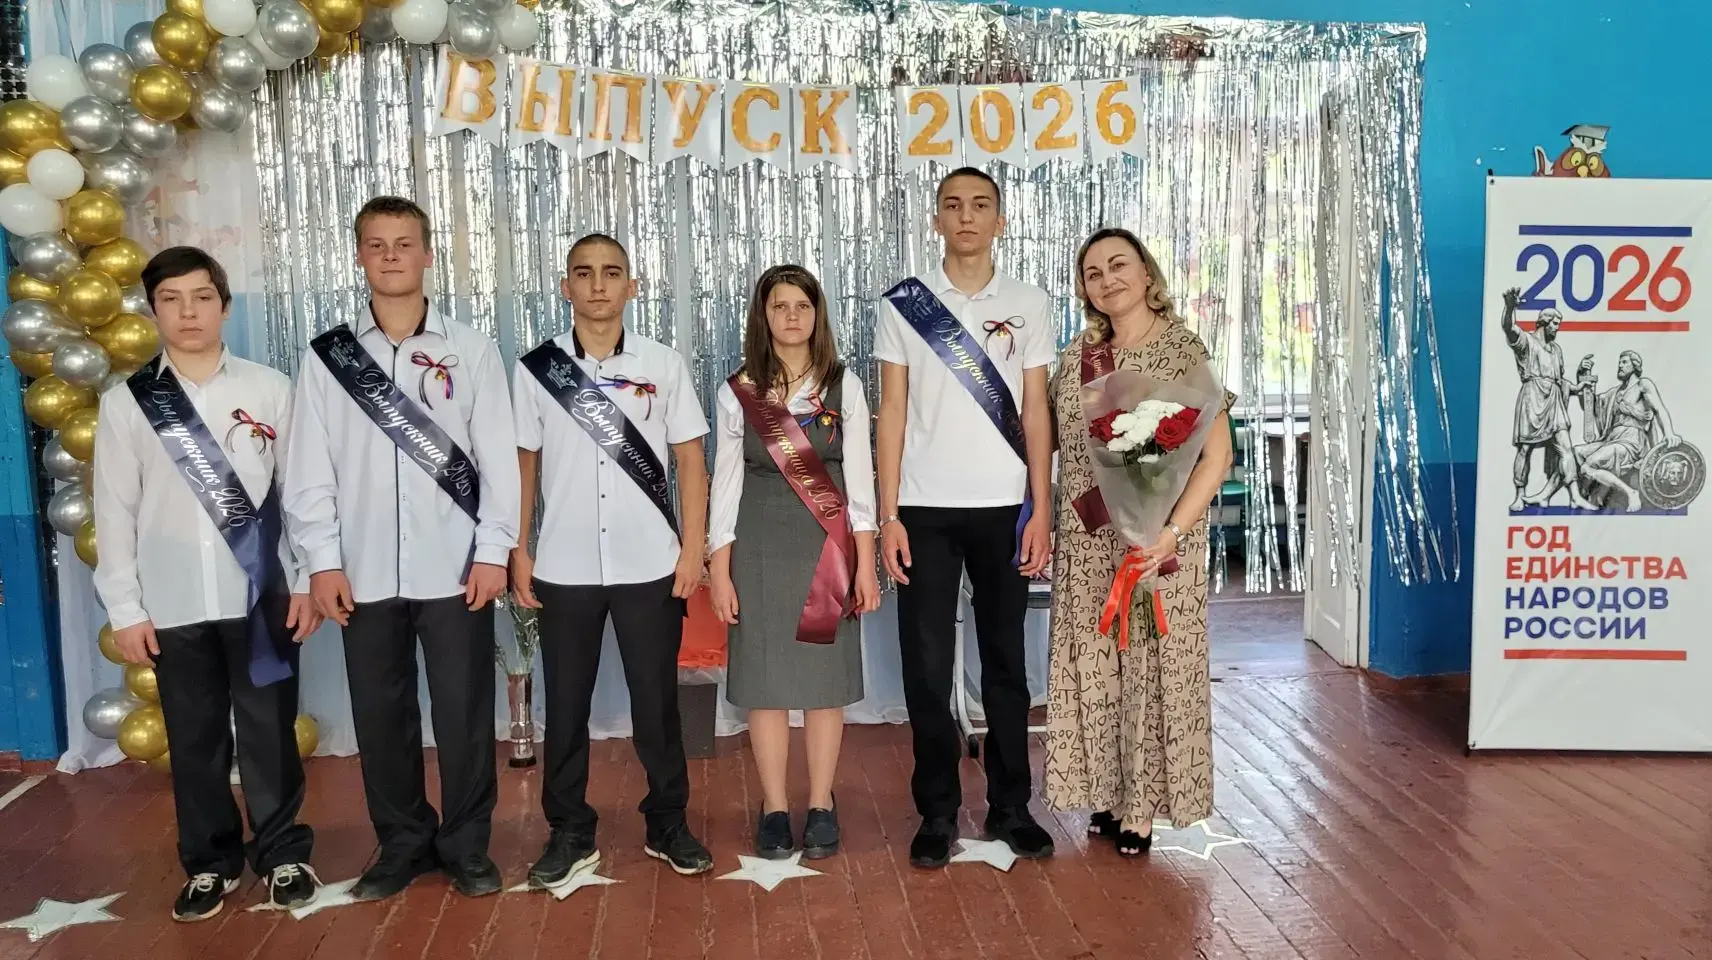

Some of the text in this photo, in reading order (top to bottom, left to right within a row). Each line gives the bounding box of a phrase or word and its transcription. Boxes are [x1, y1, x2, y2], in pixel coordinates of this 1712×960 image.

[440, 51, 1137, 156] ВЫПУСК 2026
[1516, 243, 1692, 313] 2026
[932, 316, 1002, 405] Выпускник
[150, 376, 256, 527] Выпускник 2026
[354, 368, 449, 465] Выпускник
[573, 387, 656, 480] Выпускник
[808, 483, 843, 520] 2026
[1506, 556, 1688, 583] ЕДИНСТВА
[1507, 525, 1572, 552] ГОД
[1504, 616, 1647, 640] РОССИИ
[1505, 586, 1669, 613] НАРОДОВ
